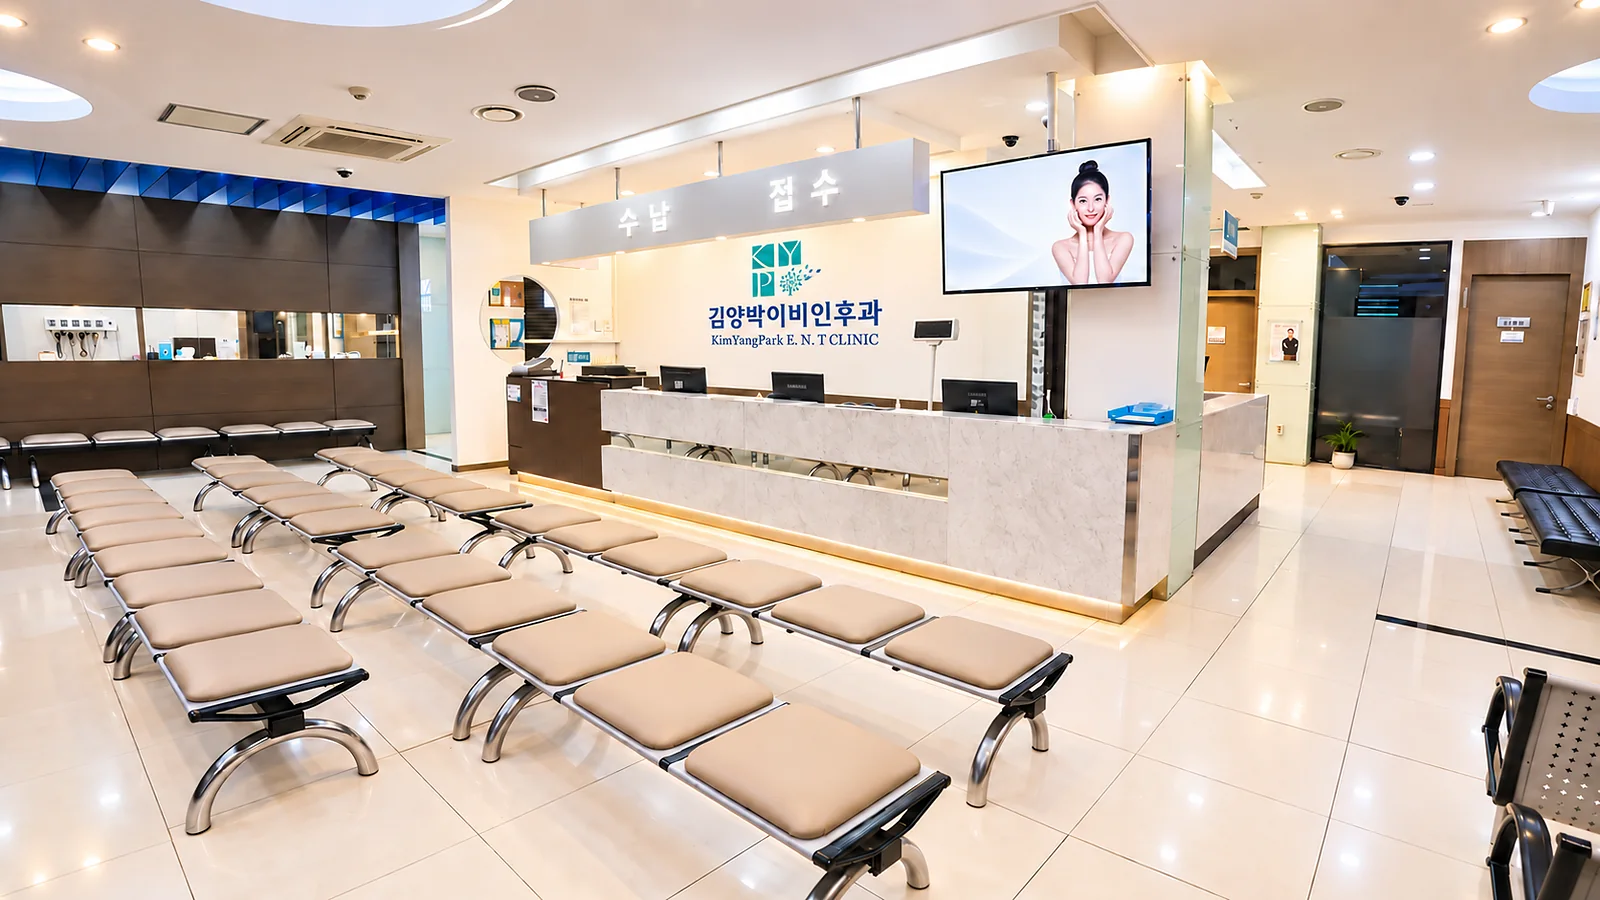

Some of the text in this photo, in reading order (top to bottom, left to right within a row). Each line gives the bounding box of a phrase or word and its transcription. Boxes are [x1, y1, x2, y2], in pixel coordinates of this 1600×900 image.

[769, 169, 841, 213] 접수
[618, 201, 670, 238] 수납
[708, 299, 883, 329] 김양박이비인후과
[711, 334, 784, 349] KimYangPark
[829, 333, 879, 346] CLINIC
